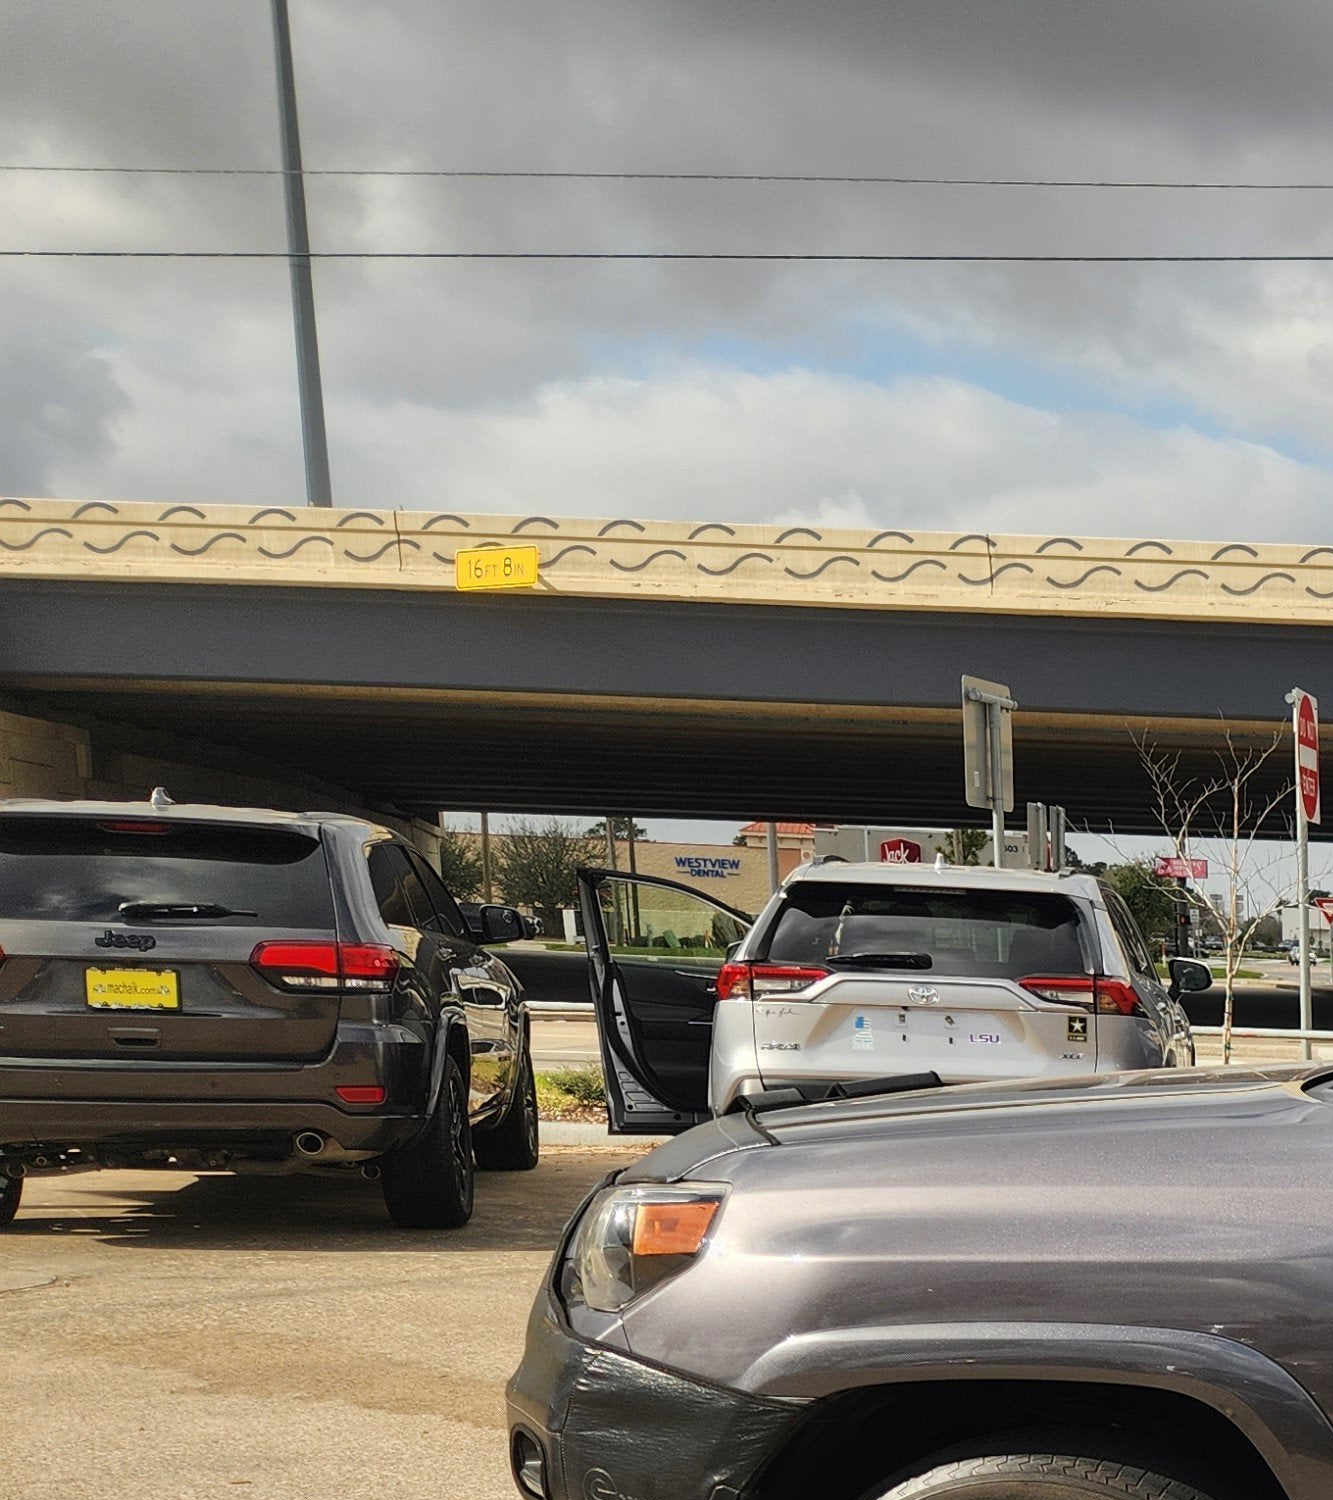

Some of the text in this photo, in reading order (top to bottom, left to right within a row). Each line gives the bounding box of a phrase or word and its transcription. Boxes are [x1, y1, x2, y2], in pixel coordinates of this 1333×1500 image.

[674, 856, 741, 870] WESTVIEW
[689, 868, 727, 878] DENTAL
[95, 930, 157, 952] Jeep
[970, 1033, 1000, 1044] LSU
